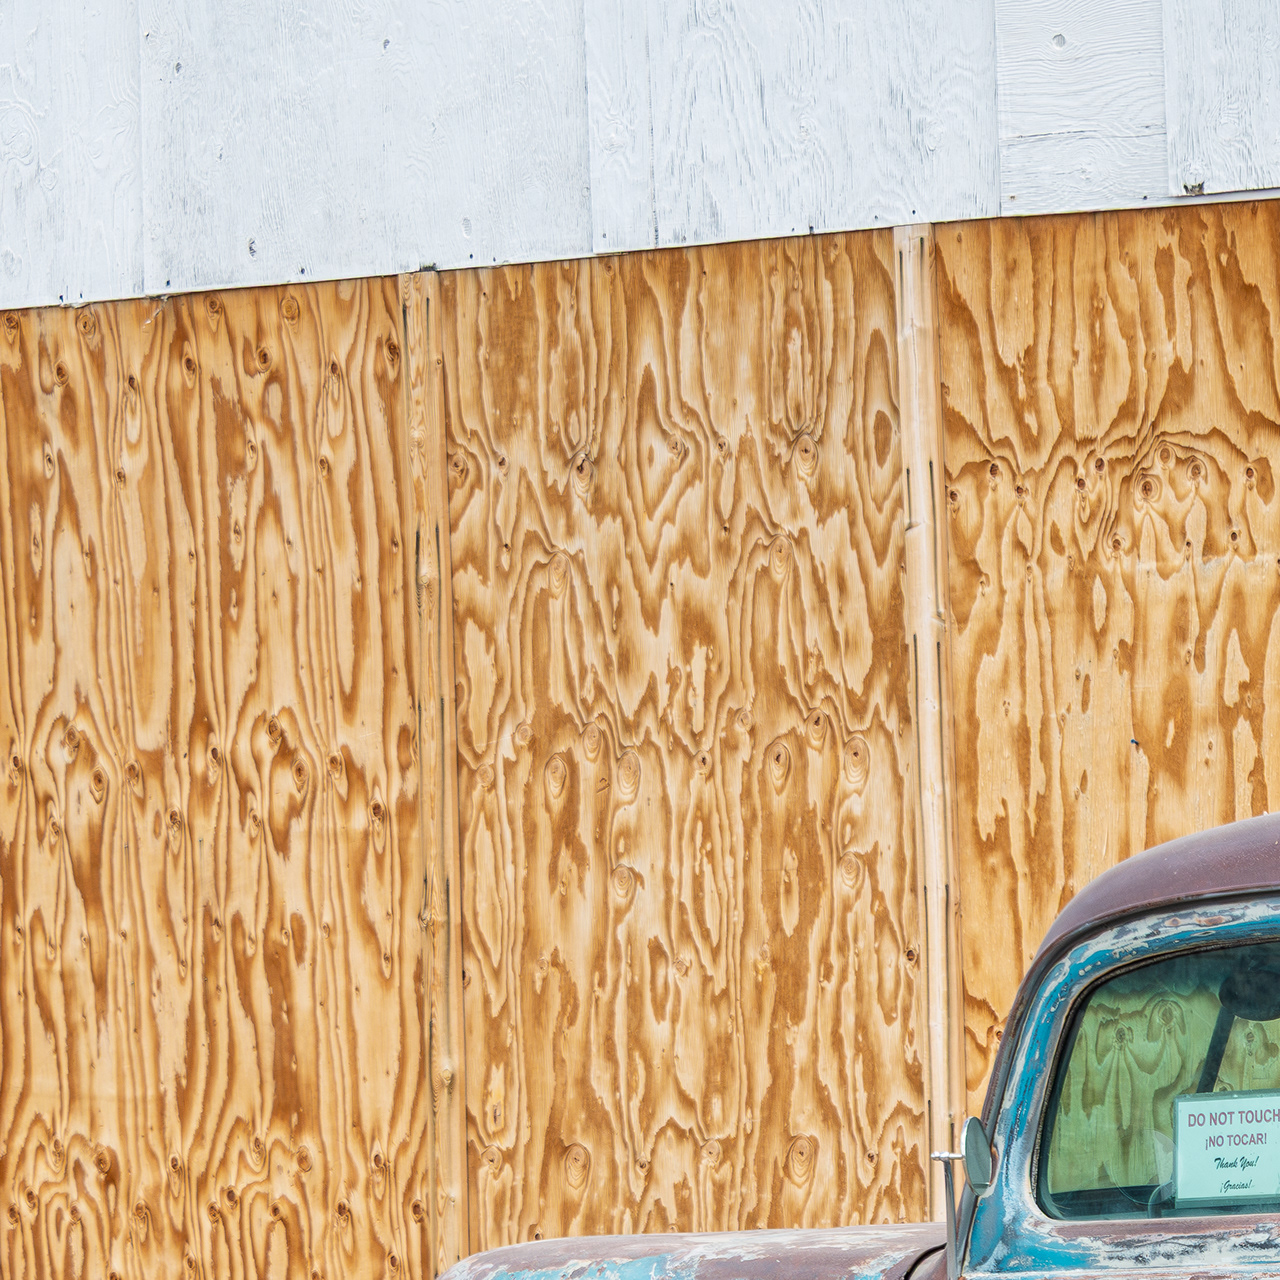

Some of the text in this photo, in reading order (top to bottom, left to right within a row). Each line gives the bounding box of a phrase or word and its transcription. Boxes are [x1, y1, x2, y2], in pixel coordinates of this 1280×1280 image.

[1187, 1113, 1206, 1127] DO
[1209, 1112, 1235, 1126] NOT
[1227, 1133, 1267, 1146] TOCAR!
[1214, 1156, 1259, 1171] Thank You!
